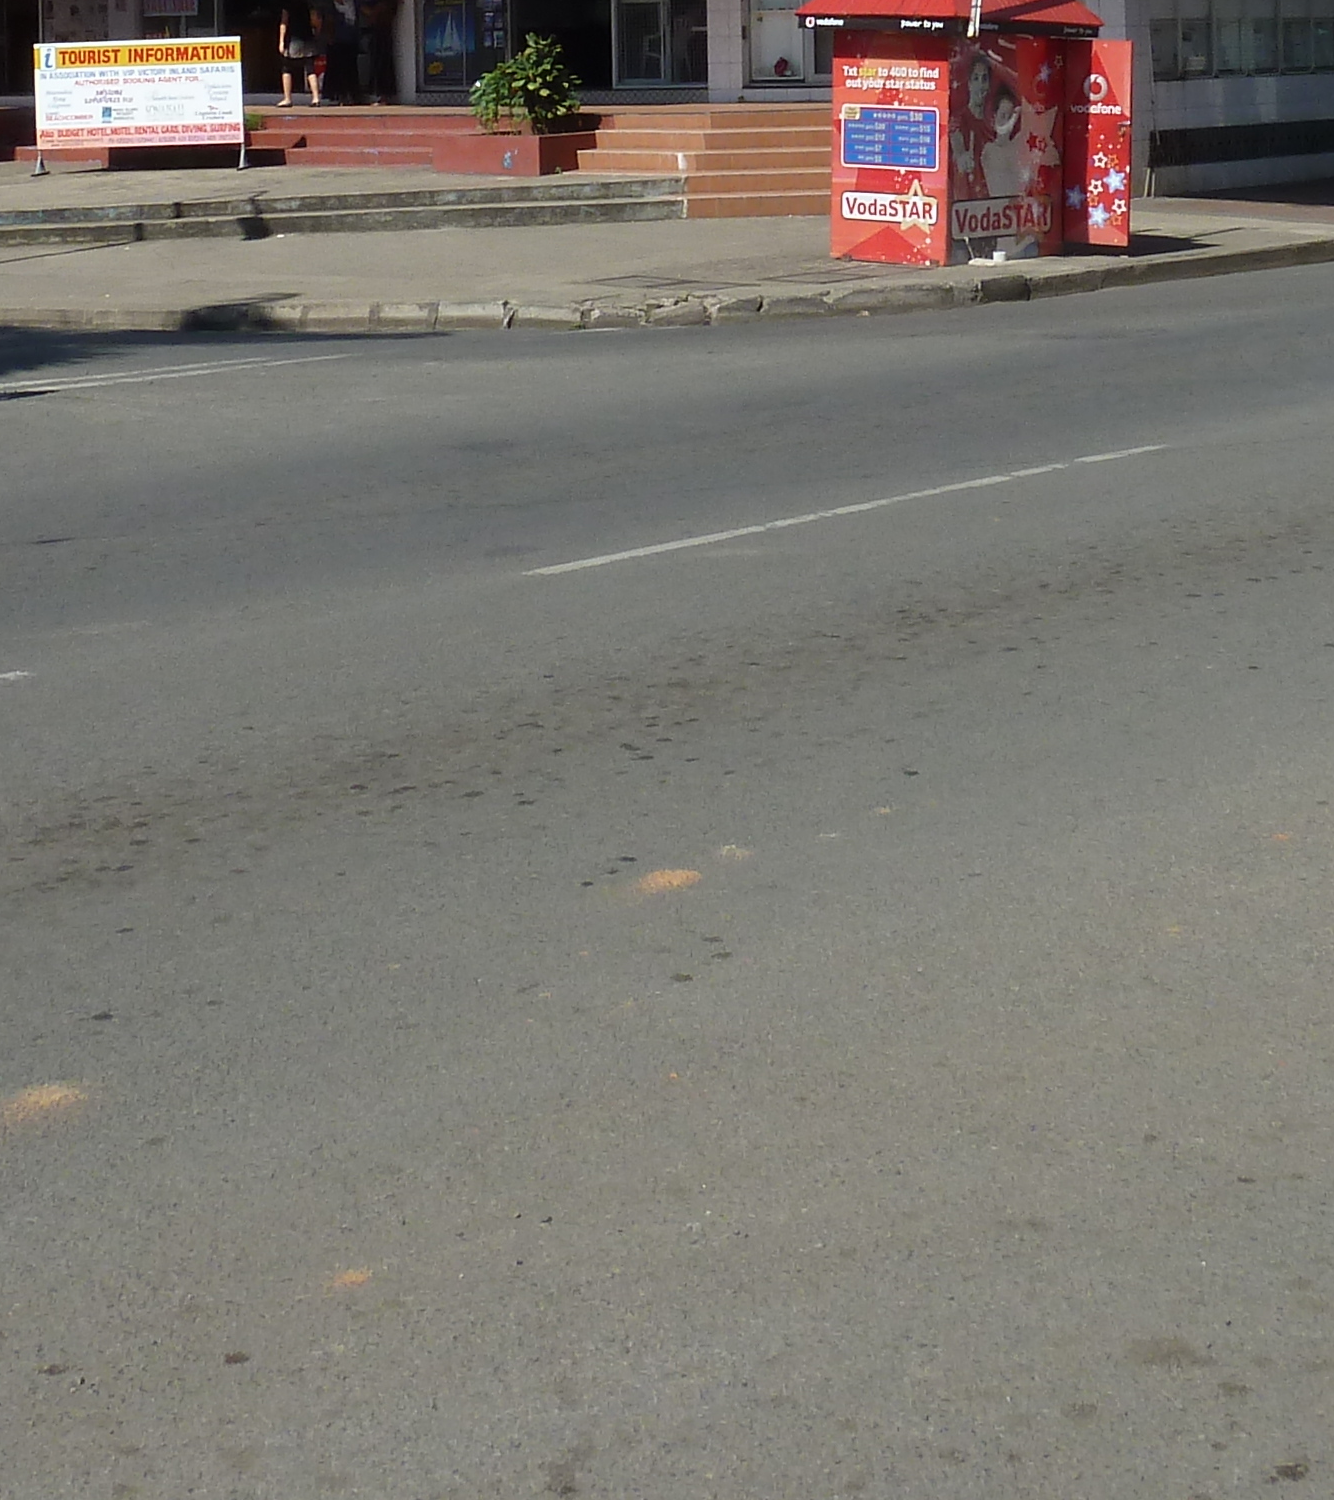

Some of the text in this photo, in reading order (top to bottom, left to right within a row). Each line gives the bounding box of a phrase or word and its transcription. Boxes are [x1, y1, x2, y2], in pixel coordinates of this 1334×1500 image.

[59, 49, 120, 65] TOURIST
[128, 45, 236, 63] INFORMATION
[199, 66, 235, 74] SAFARIS
[843, 66, 857, 76] Txt
[878, 67, 888, 77] to
[908, 68, 918, 77] to
[919, 67, 939, 78] find
[845, 78, 936, 90] out your star status
[1070, 102, 1122, 116] vodafone
[846, 196, 934, 221] VodaSTAR
[955, 203, 1050, 233] VodaSTAR
